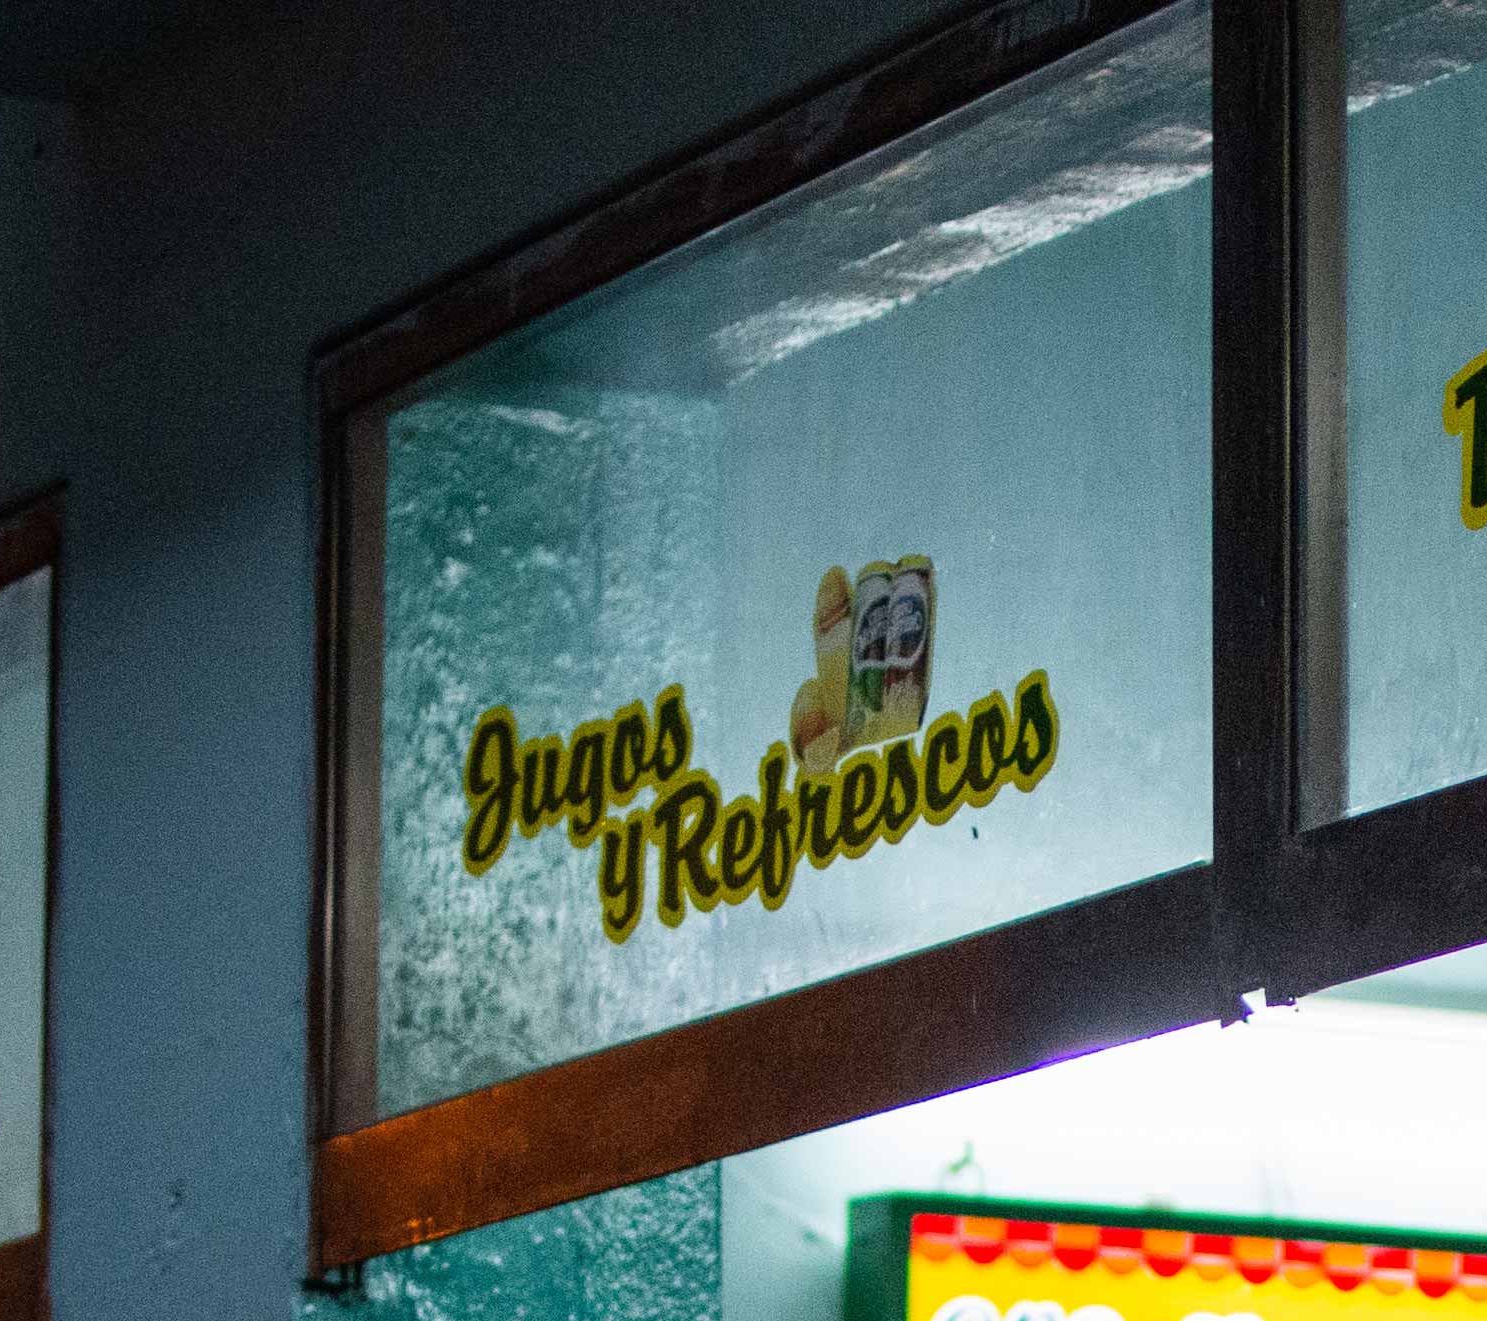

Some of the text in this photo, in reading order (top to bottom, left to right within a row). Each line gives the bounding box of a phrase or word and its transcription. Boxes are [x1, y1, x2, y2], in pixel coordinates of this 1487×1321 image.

[464, 688, 686, 864] Jugos
[601, 678, 1054, 936] y Refrescos
